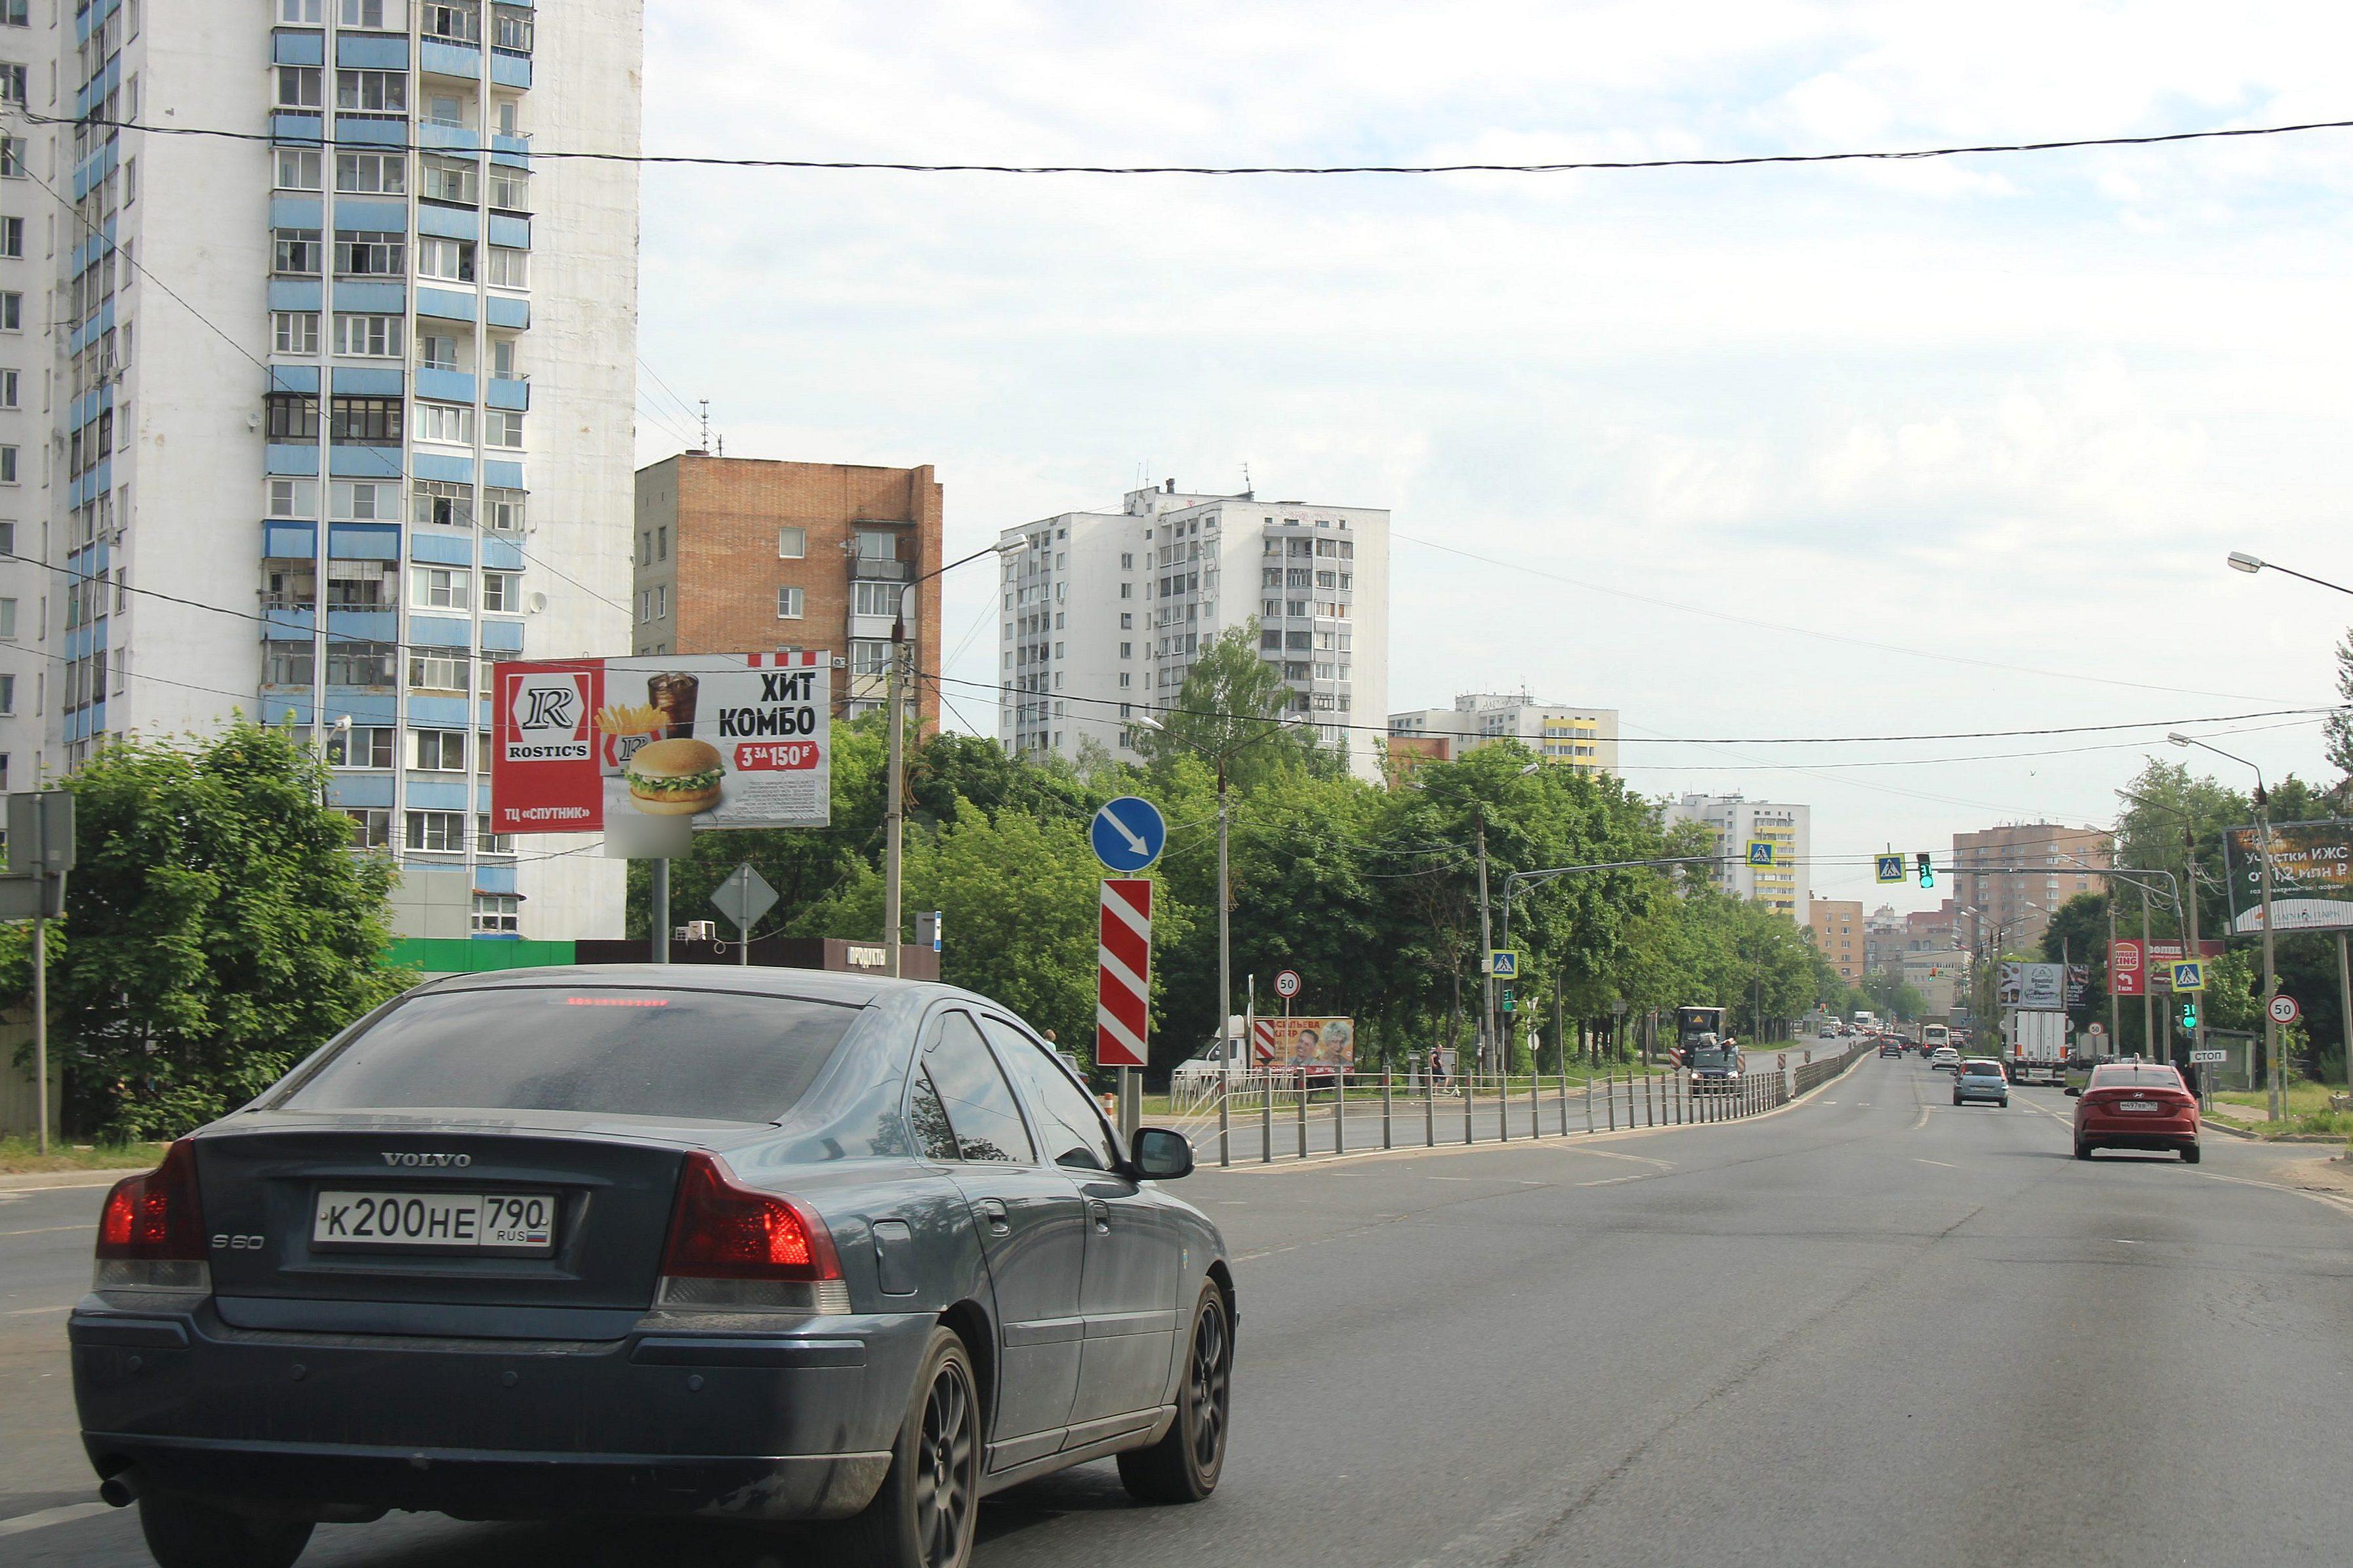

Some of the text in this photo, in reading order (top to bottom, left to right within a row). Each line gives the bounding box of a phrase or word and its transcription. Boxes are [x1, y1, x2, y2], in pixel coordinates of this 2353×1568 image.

[761, 672, 815, 701] ХИТ
[522, 688, 573, 730] R
[720, 706, 815, 736] КОМБО
[510, 746, 586, 757] ROSTIC'S
[741, 747, 753, 767] 3
[769, 746, 800, 766] 150
[504, 807, 590, 822] ТЦ «СПУТНИК»
[2311, 847, 2348, 860] ИЖС
[2248, 871, 2262, 882] о
[1280, 979, 1294, 989] 50
[2183, 1004, 2196, 1015] 31
[2275, 1005, 2291, 1015] 50
[381, 1152, 471, 1167] VOLVO
[488, 1198, 544, 1229] 790
[497, 1230, 525, 1241] RUS
